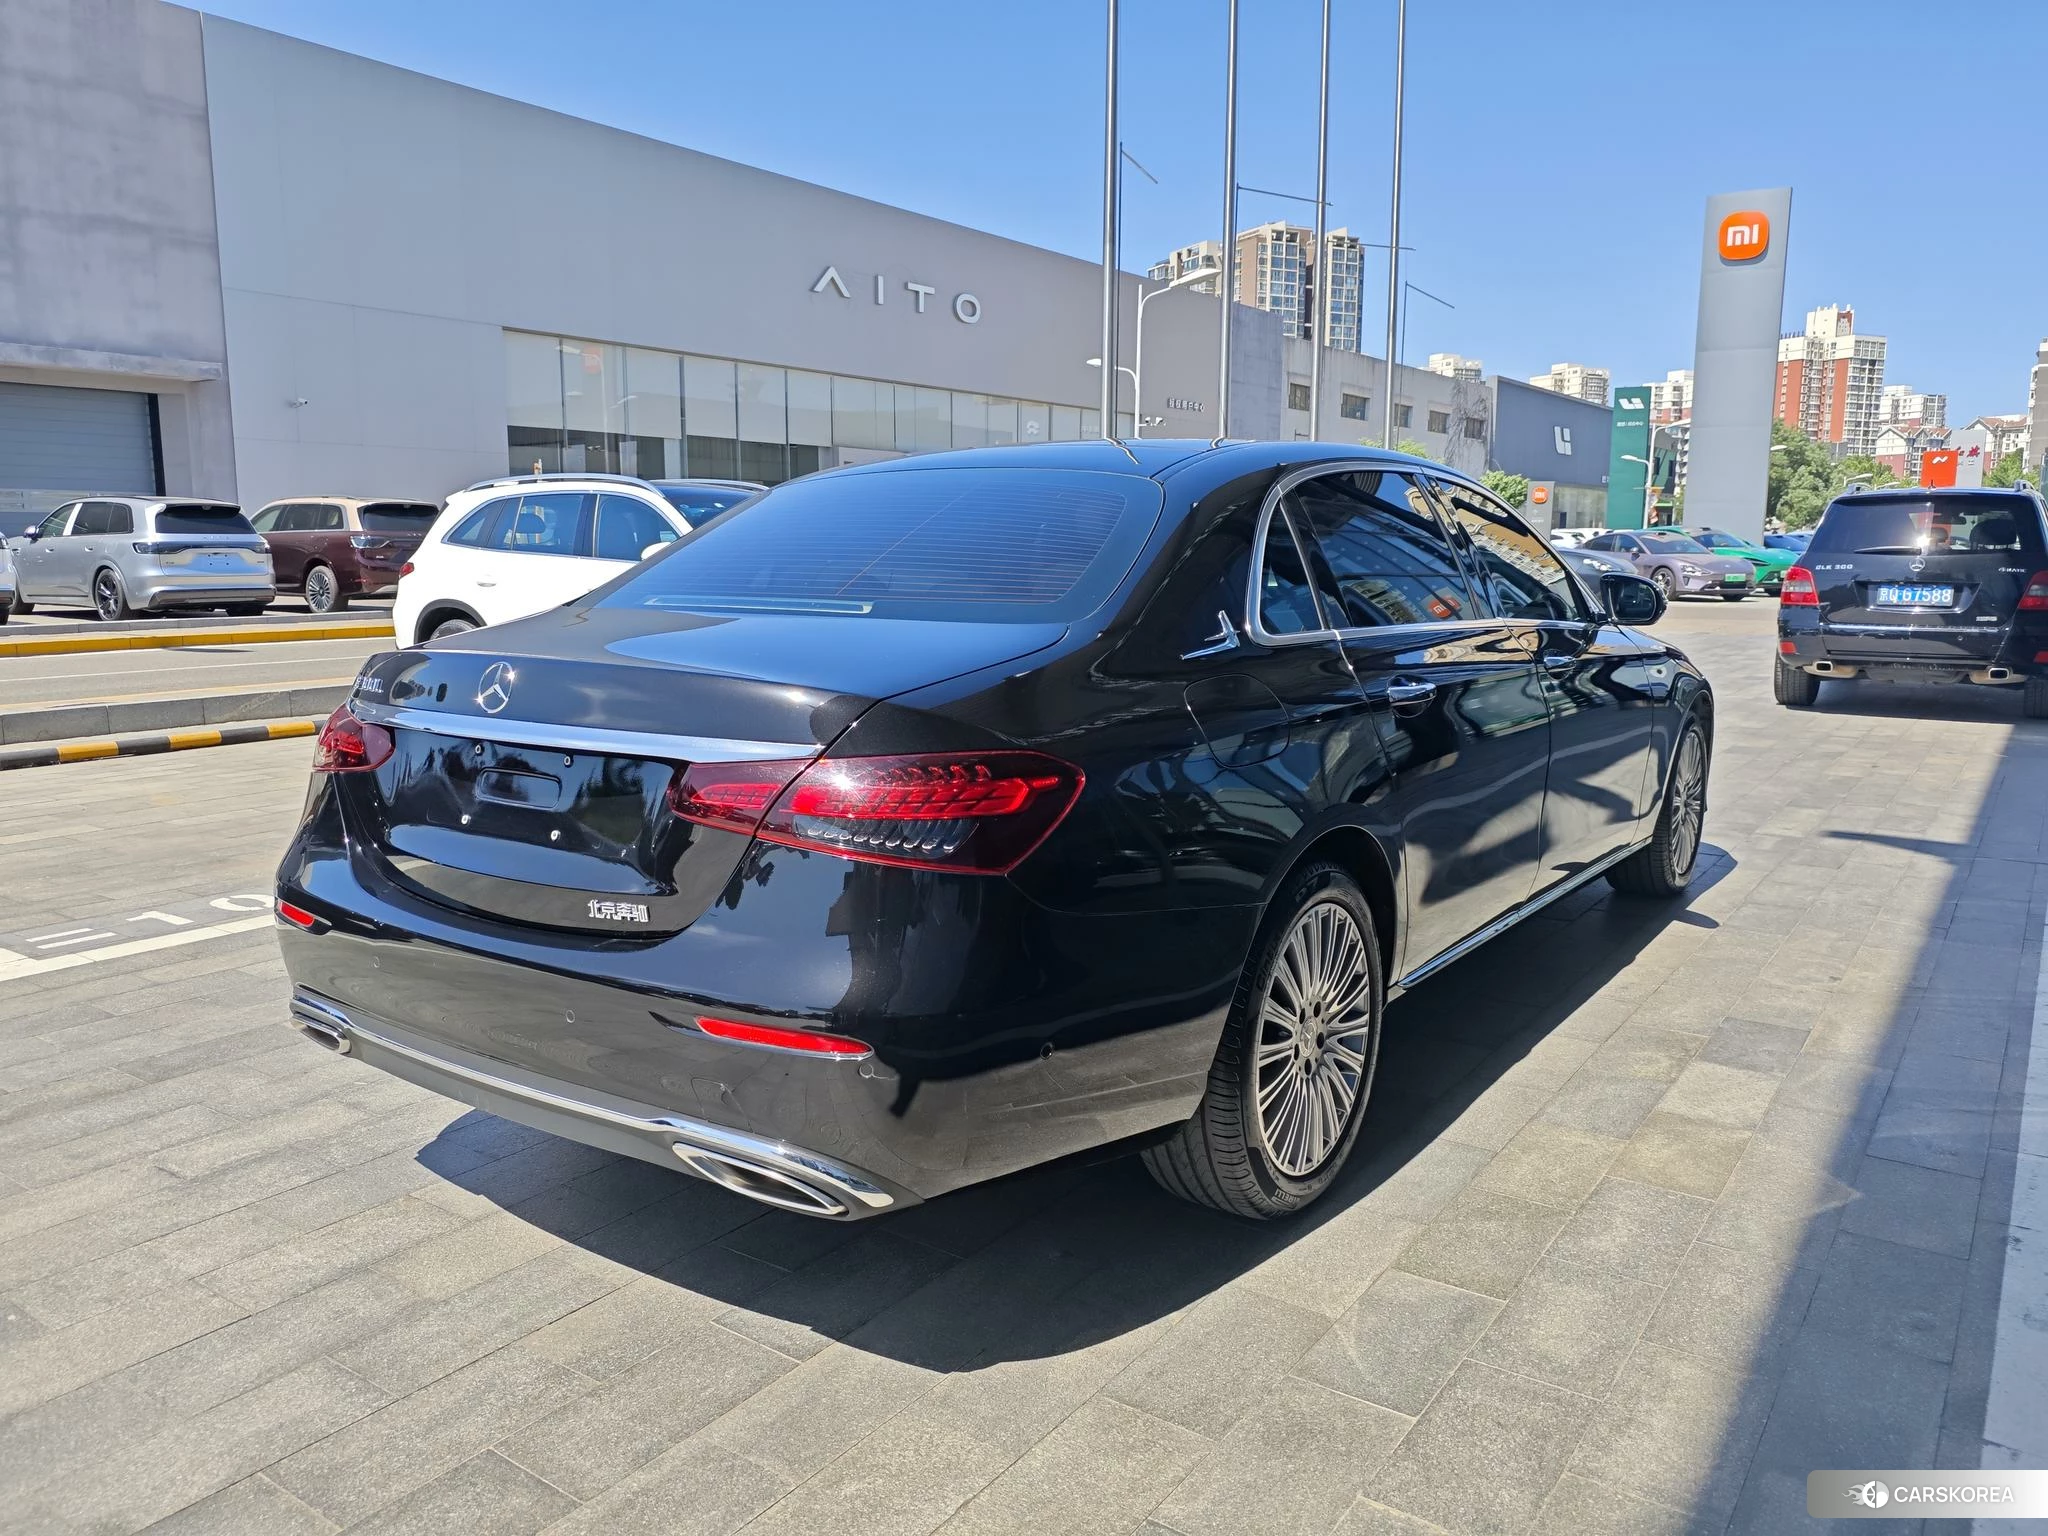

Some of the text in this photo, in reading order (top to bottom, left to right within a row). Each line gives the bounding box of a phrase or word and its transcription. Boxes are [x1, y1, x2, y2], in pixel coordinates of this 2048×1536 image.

[810, 265, 982, 325] AITO
[587, 899, 650, 923] 北京奔驰
